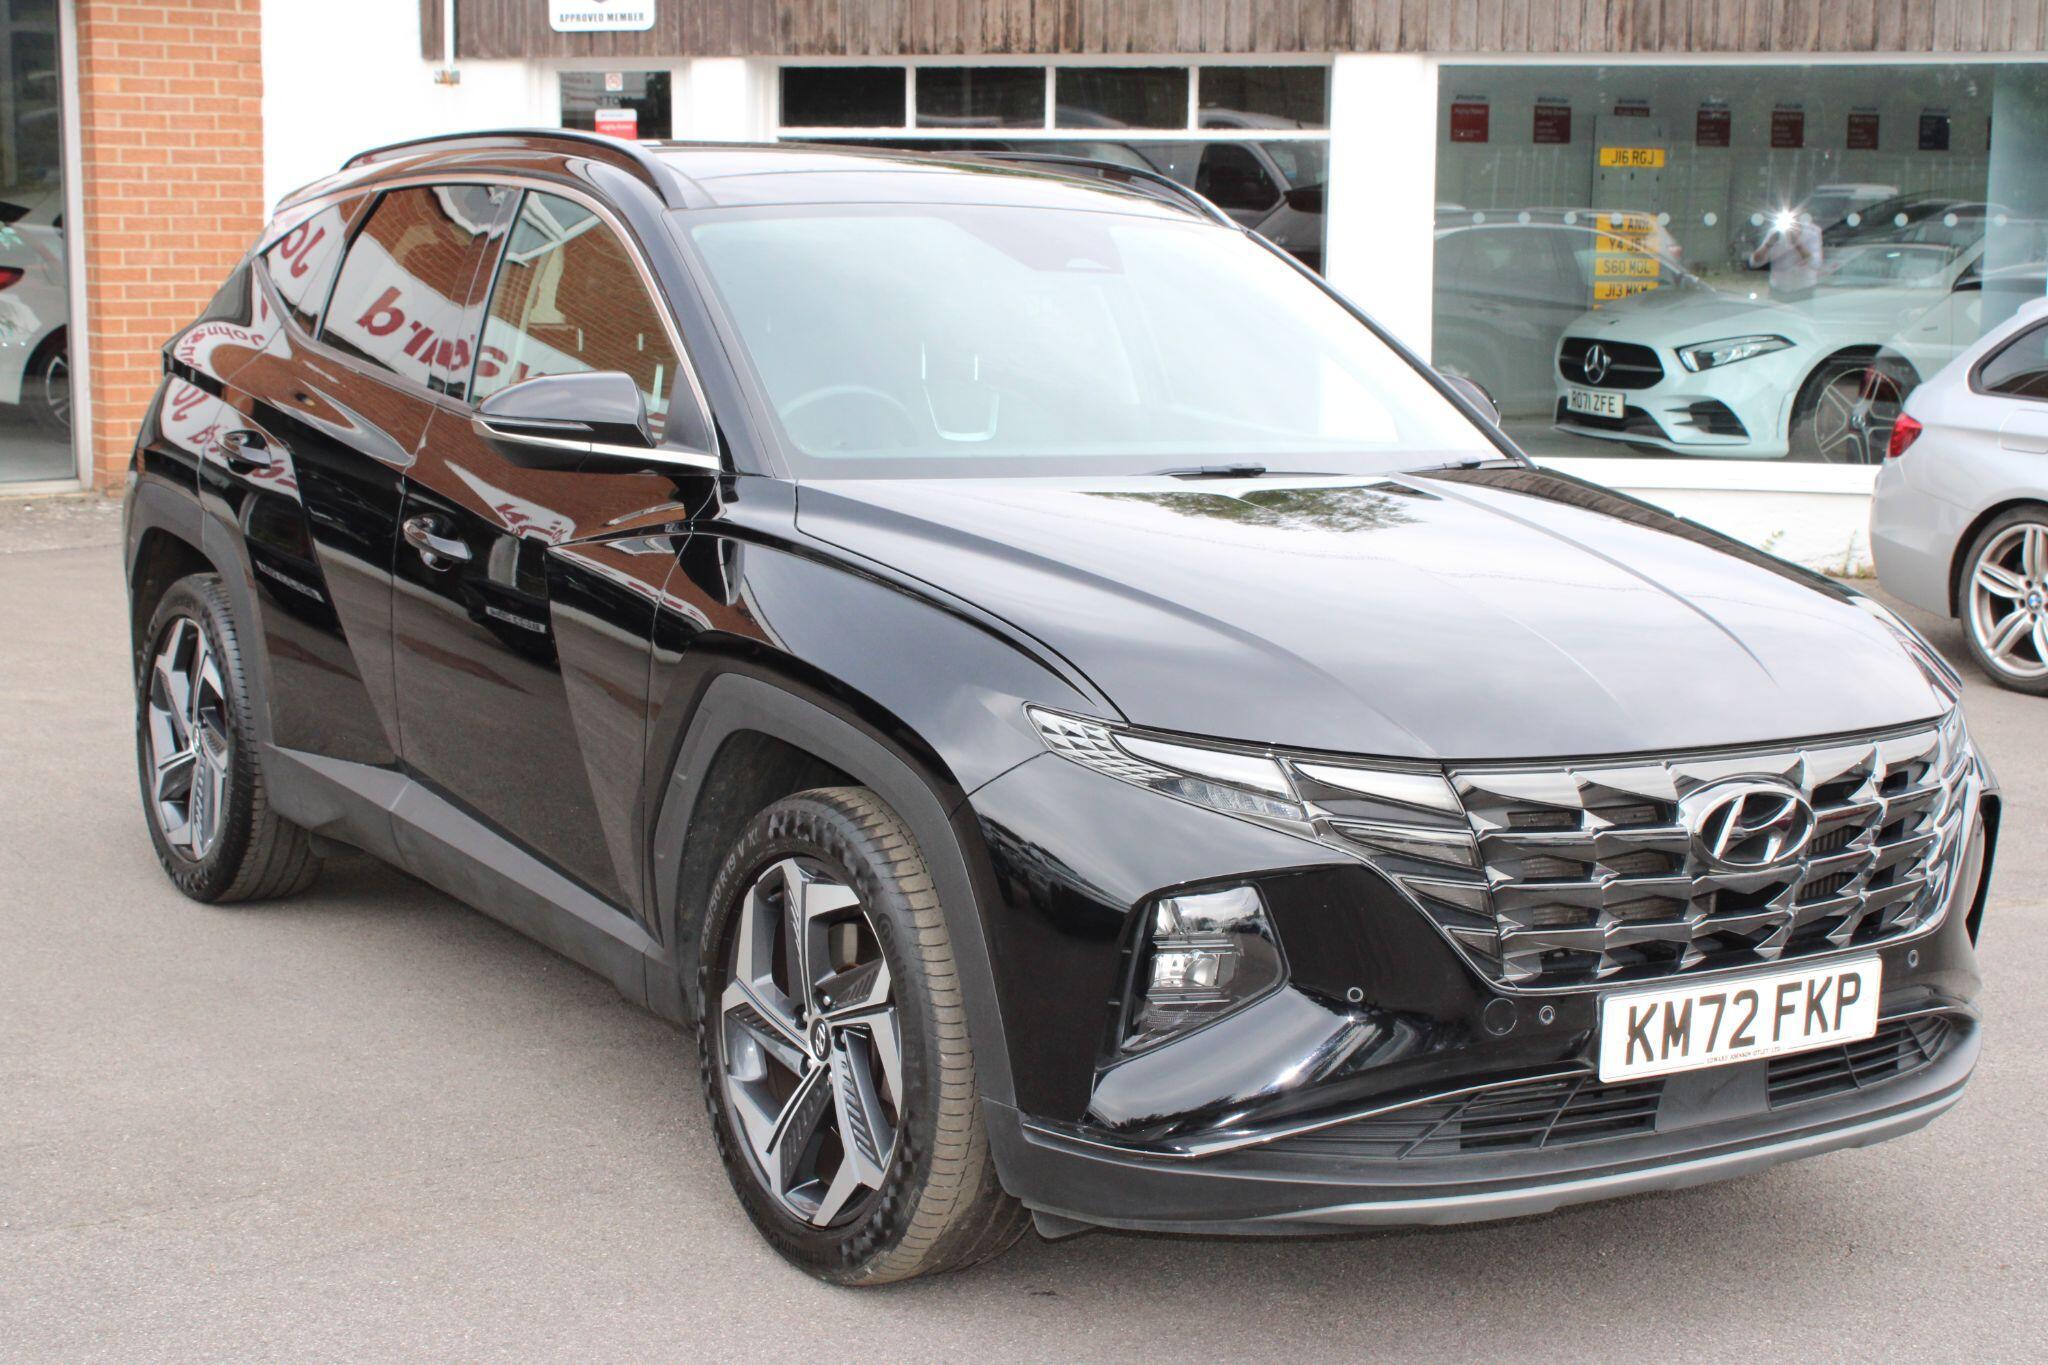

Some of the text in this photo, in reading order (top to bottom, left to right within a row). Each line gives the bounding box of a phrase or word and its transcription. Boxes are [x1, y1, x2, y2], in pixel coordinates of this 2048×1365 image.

[559, 12, 645, 23] APPROVED MEMBER
[1611, 149, 1655, 165] J16 RGJ
[1603, 259, 1626, 274] S60
[1593, 393, 1616, 413] ZFE
[1625, 972, 1862, 1066] KM72 FKP
